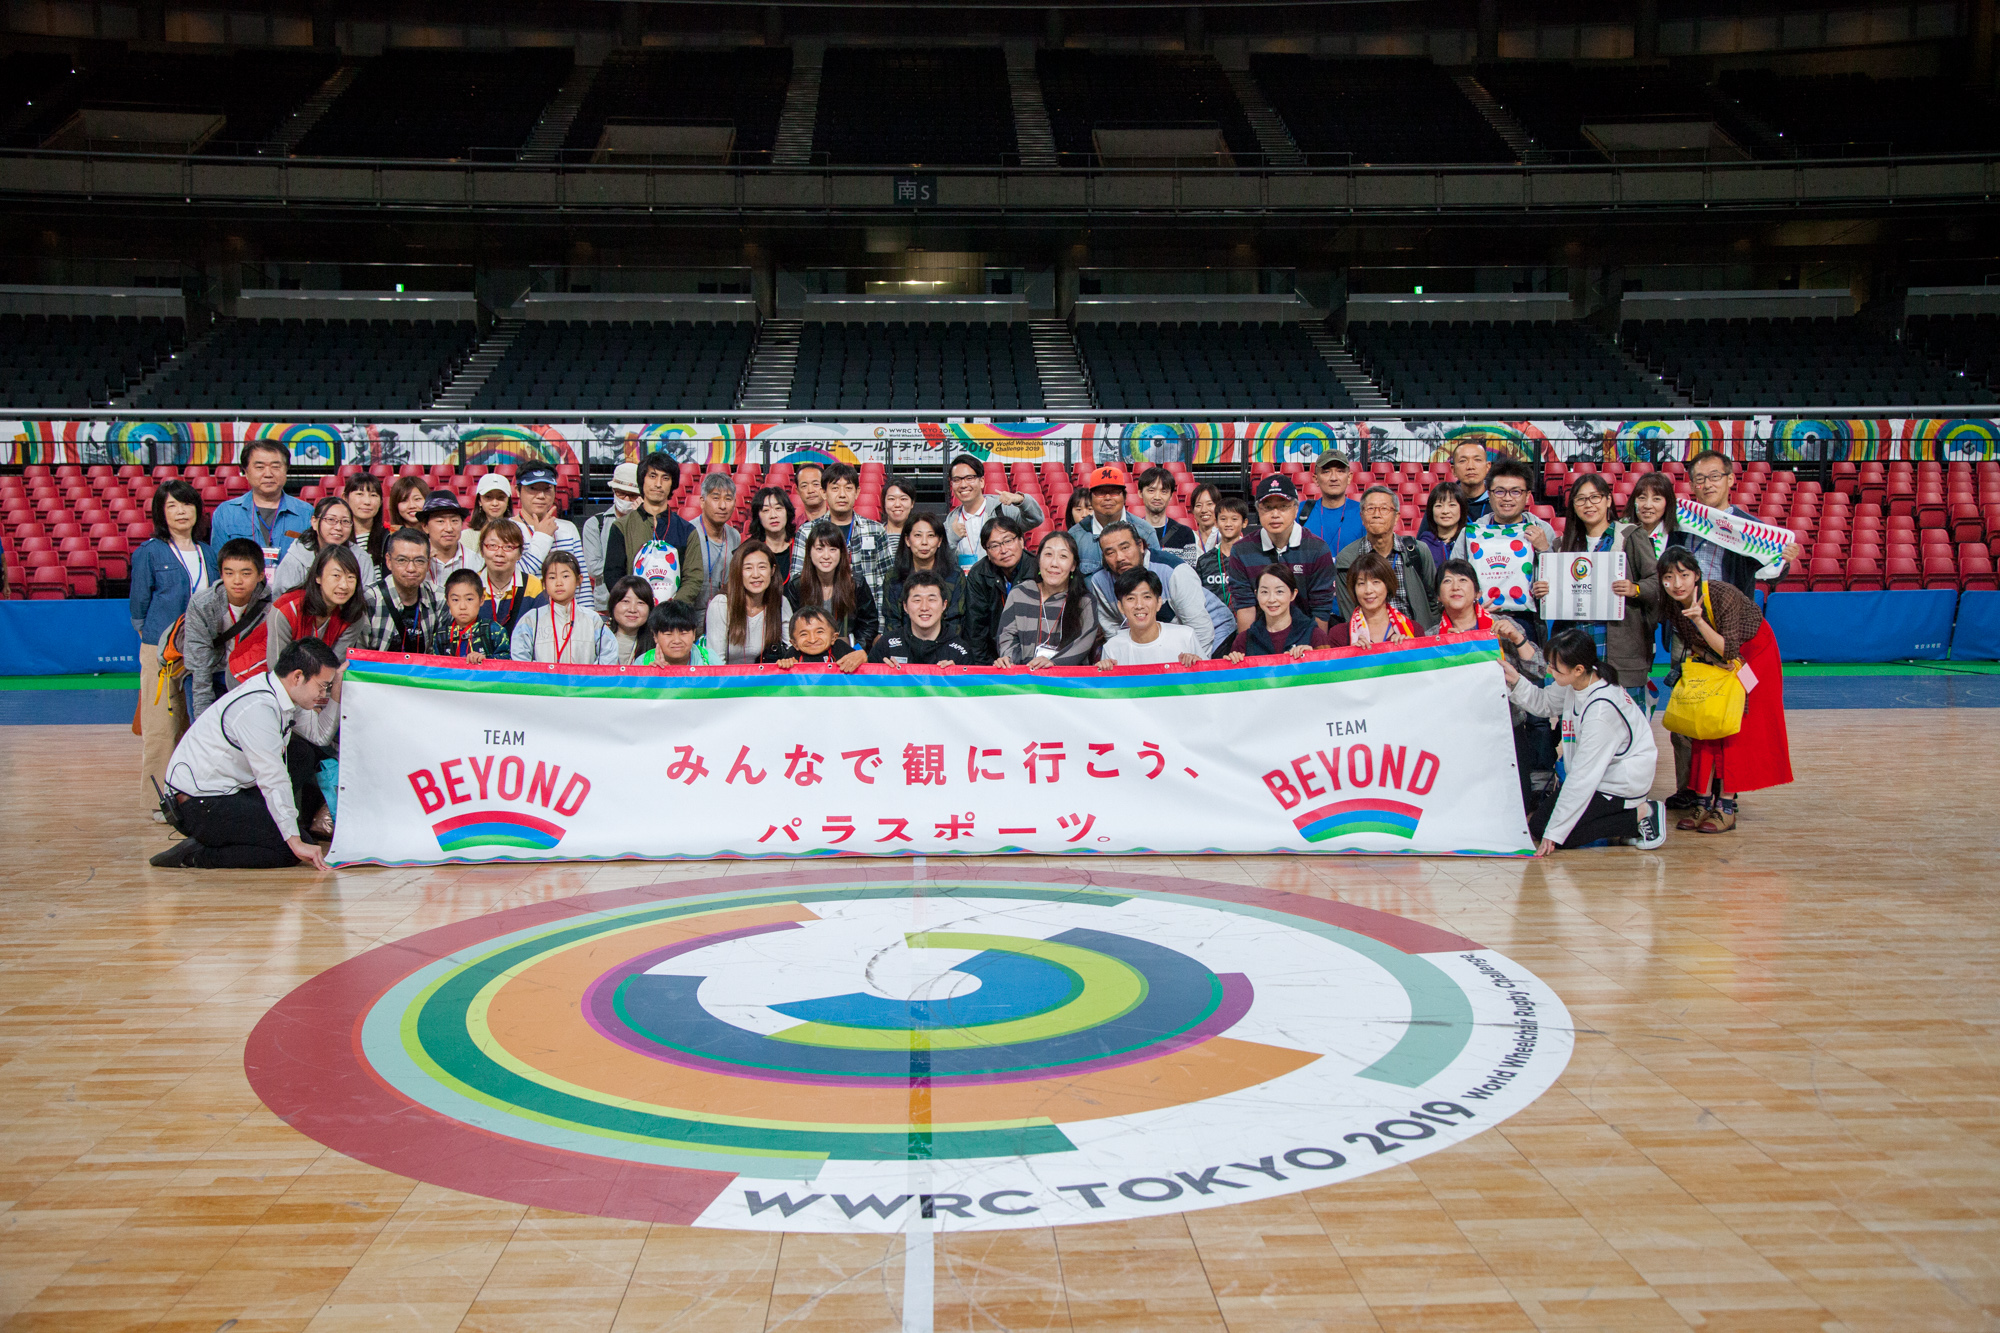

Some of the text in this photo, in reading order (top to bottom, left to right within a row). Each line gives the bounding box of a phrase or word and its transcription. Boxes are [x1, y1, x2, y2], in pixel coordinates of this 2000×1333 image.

[645, 568, 668, 578] BEYOND
[1485, 555, 1510, 565] BEYOND
[948, 642, 968, 655] JAPAN
[483, 729, 525, 746] TEAM
[1326, 718, 1367, 737] TEAM
[666, 740, 1199, 787] みんなで観に行こう、
[407, 755, 591, 817] BEYOND
[1261, 743, 1440, 811] BEYOND
[757, 811, 1111, 844] パラスポーツ。
[744, 954, 1538, 1219] WWRC TOKYO 2019 World Wheelchair Rugby Challenge
